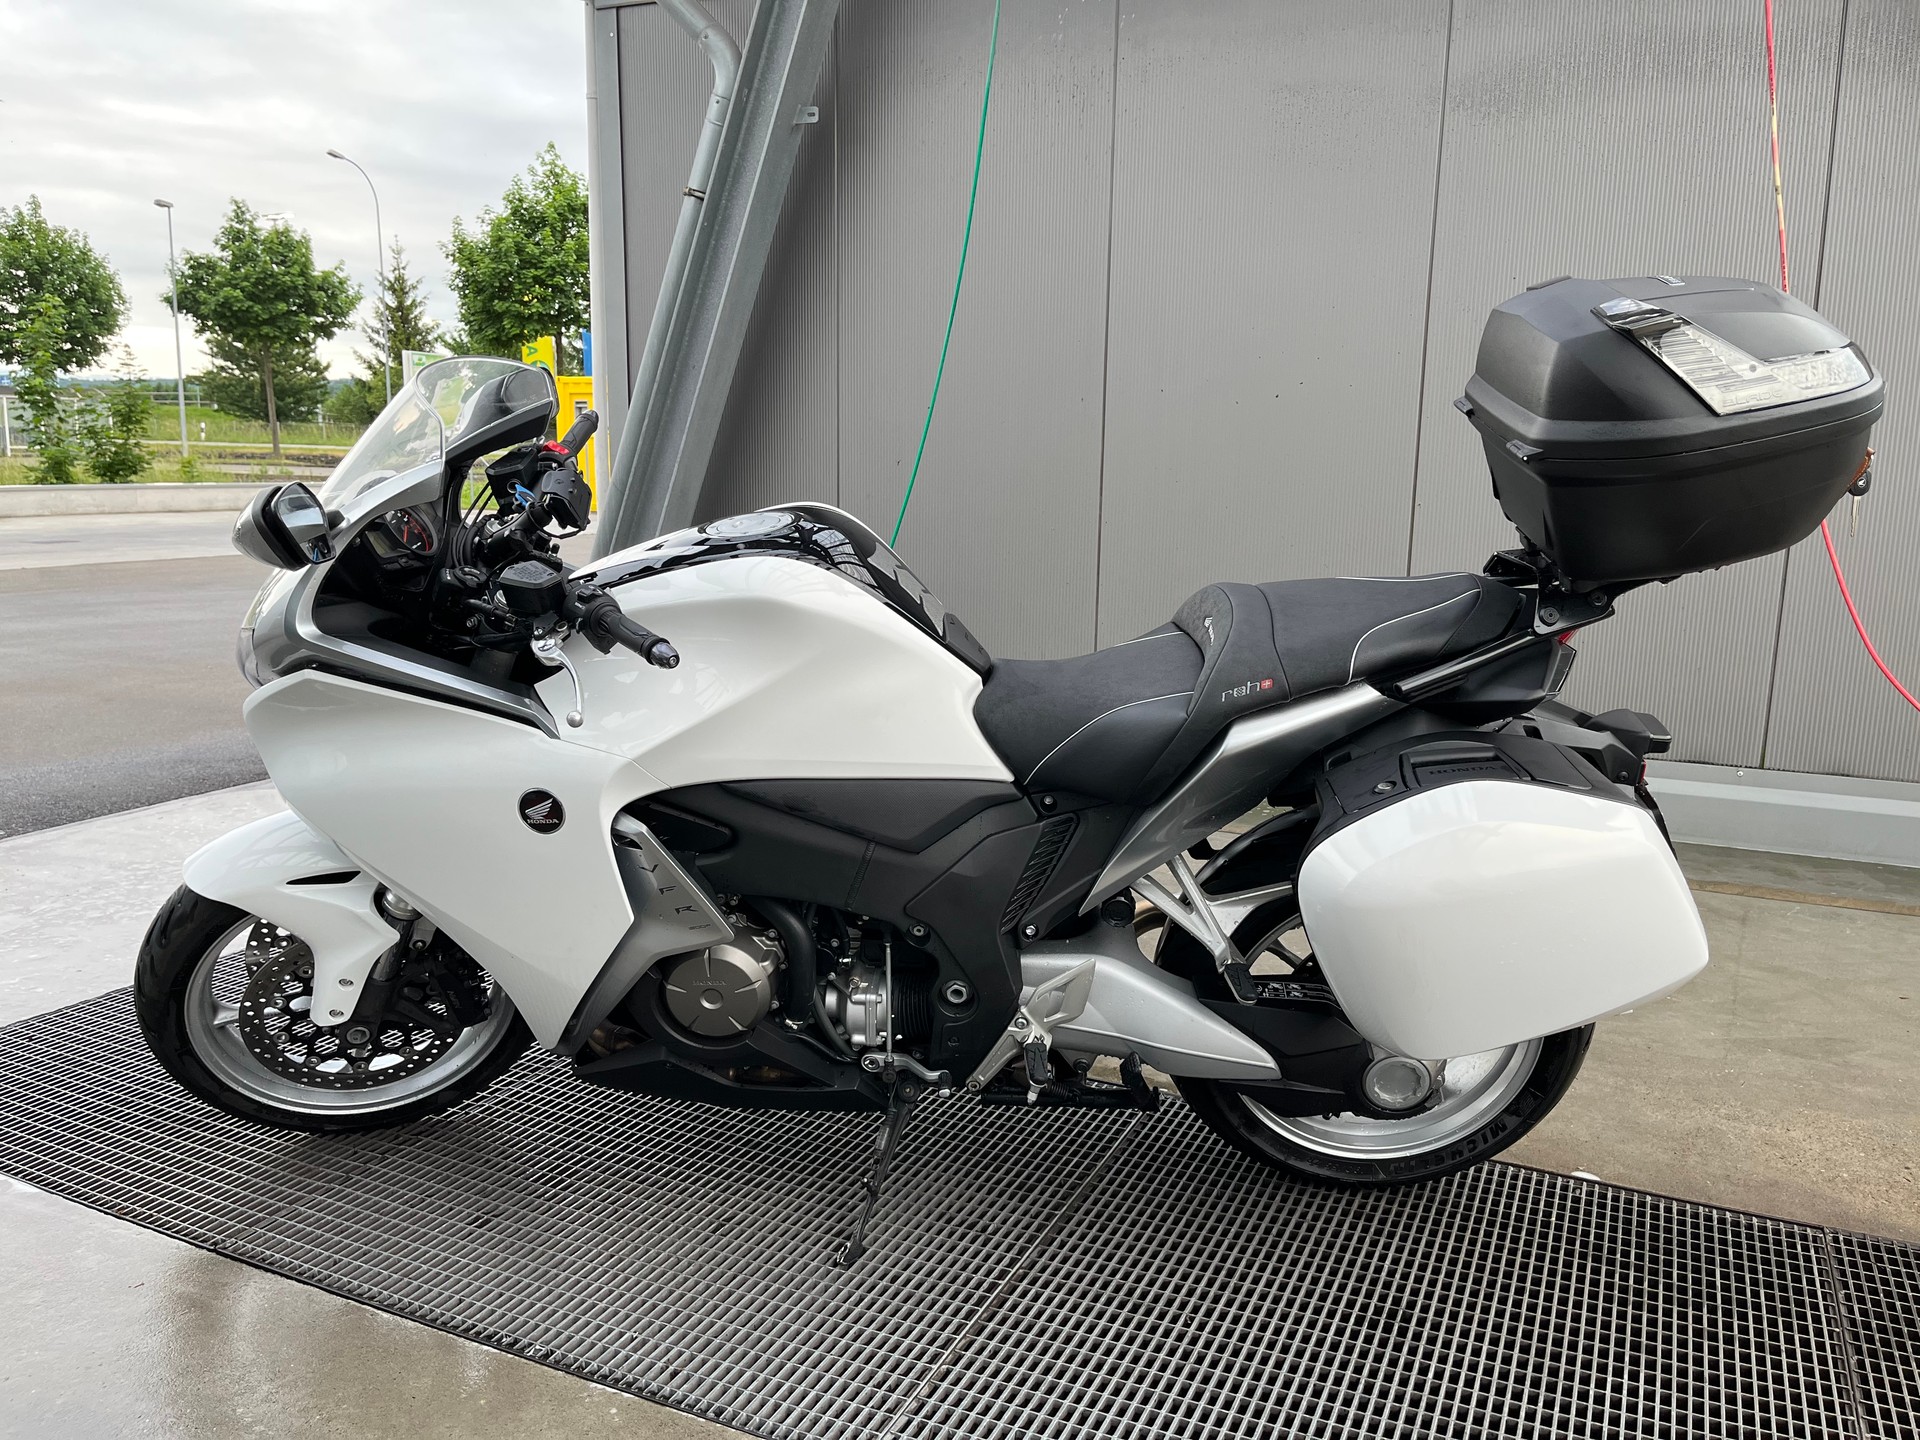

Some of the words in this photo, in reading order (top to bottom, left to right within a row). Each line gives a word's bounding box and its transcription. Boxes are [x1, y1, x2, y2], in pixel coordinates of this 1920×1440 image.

[1428, 765, 1497, 776] HONDA
[639, 863, 699, 915] VFR
[1389, 1119, 1509, 1176] MICHELIN
